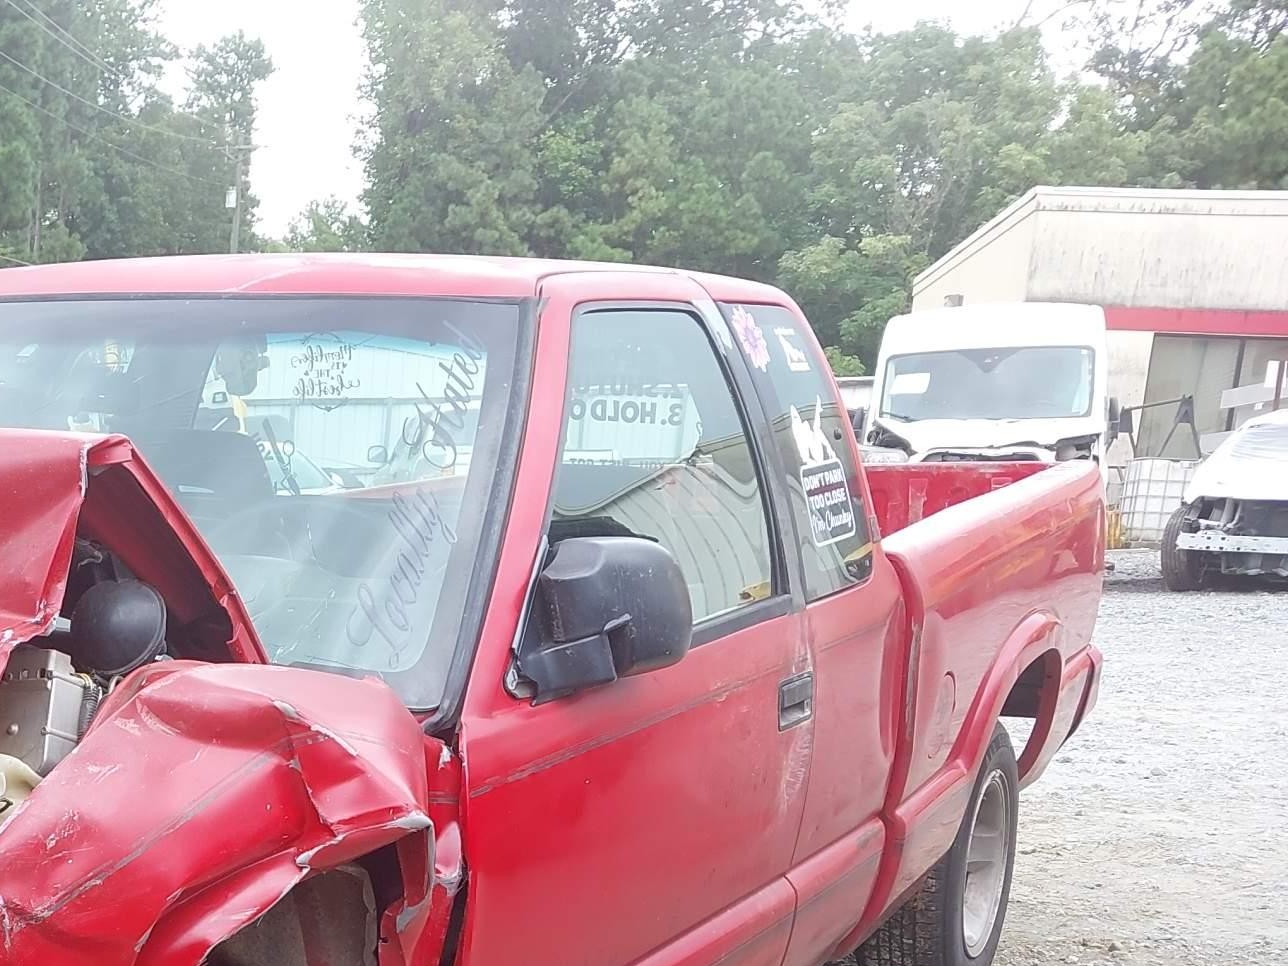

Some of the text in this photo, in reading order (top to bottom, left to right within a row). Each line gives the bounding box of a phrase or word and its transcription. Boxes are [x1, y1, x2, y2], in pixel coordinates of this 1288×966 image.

[402, 319, 485, 470] Hated
[824, 468, 844, 486] PARK
[809, 488, 847, 510] TOO CLOSE
[825, 509, 852, 532] Chunky
